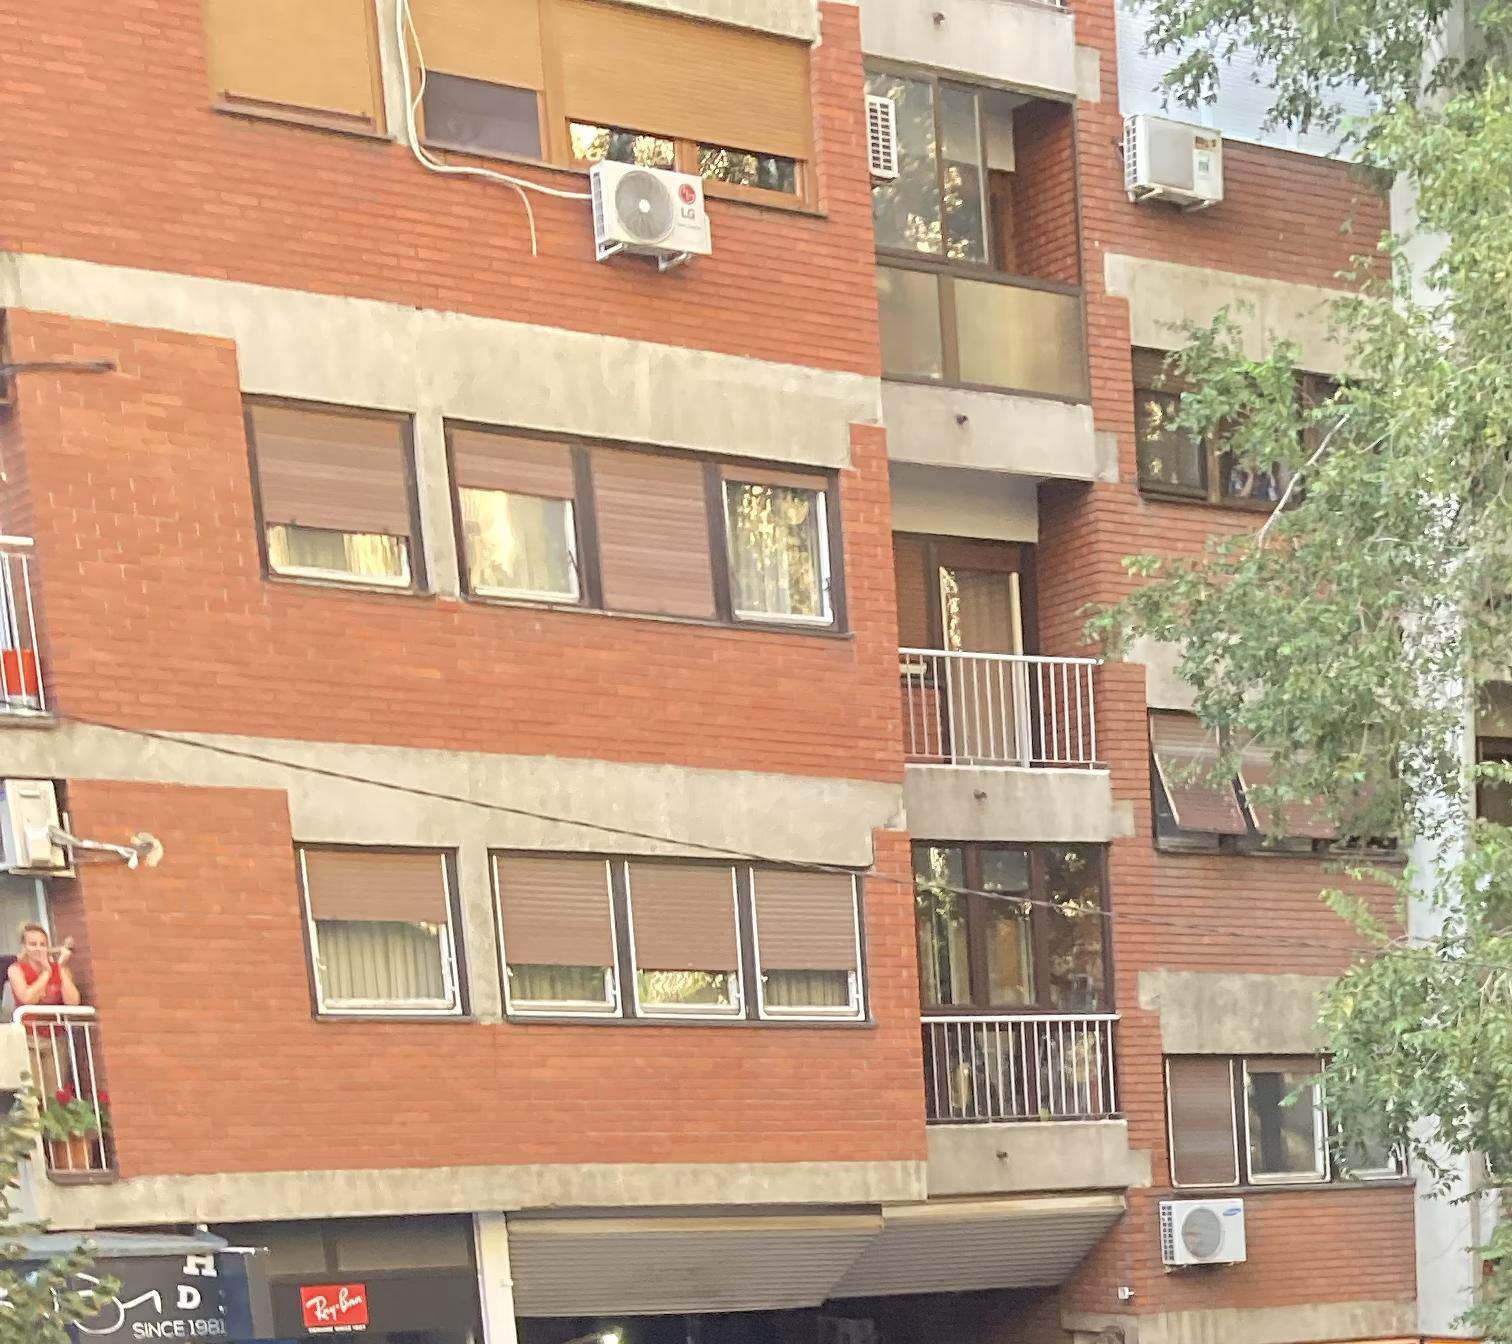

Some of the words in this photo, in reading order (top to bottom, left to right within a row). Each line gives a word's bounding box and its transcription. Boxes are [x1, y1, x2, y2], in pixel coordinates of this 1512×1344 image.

[681, 206, 696, 220] LG
[132, 1319, 186, 1340] SINCE
[189, 1318, 226, 1338] 1981
